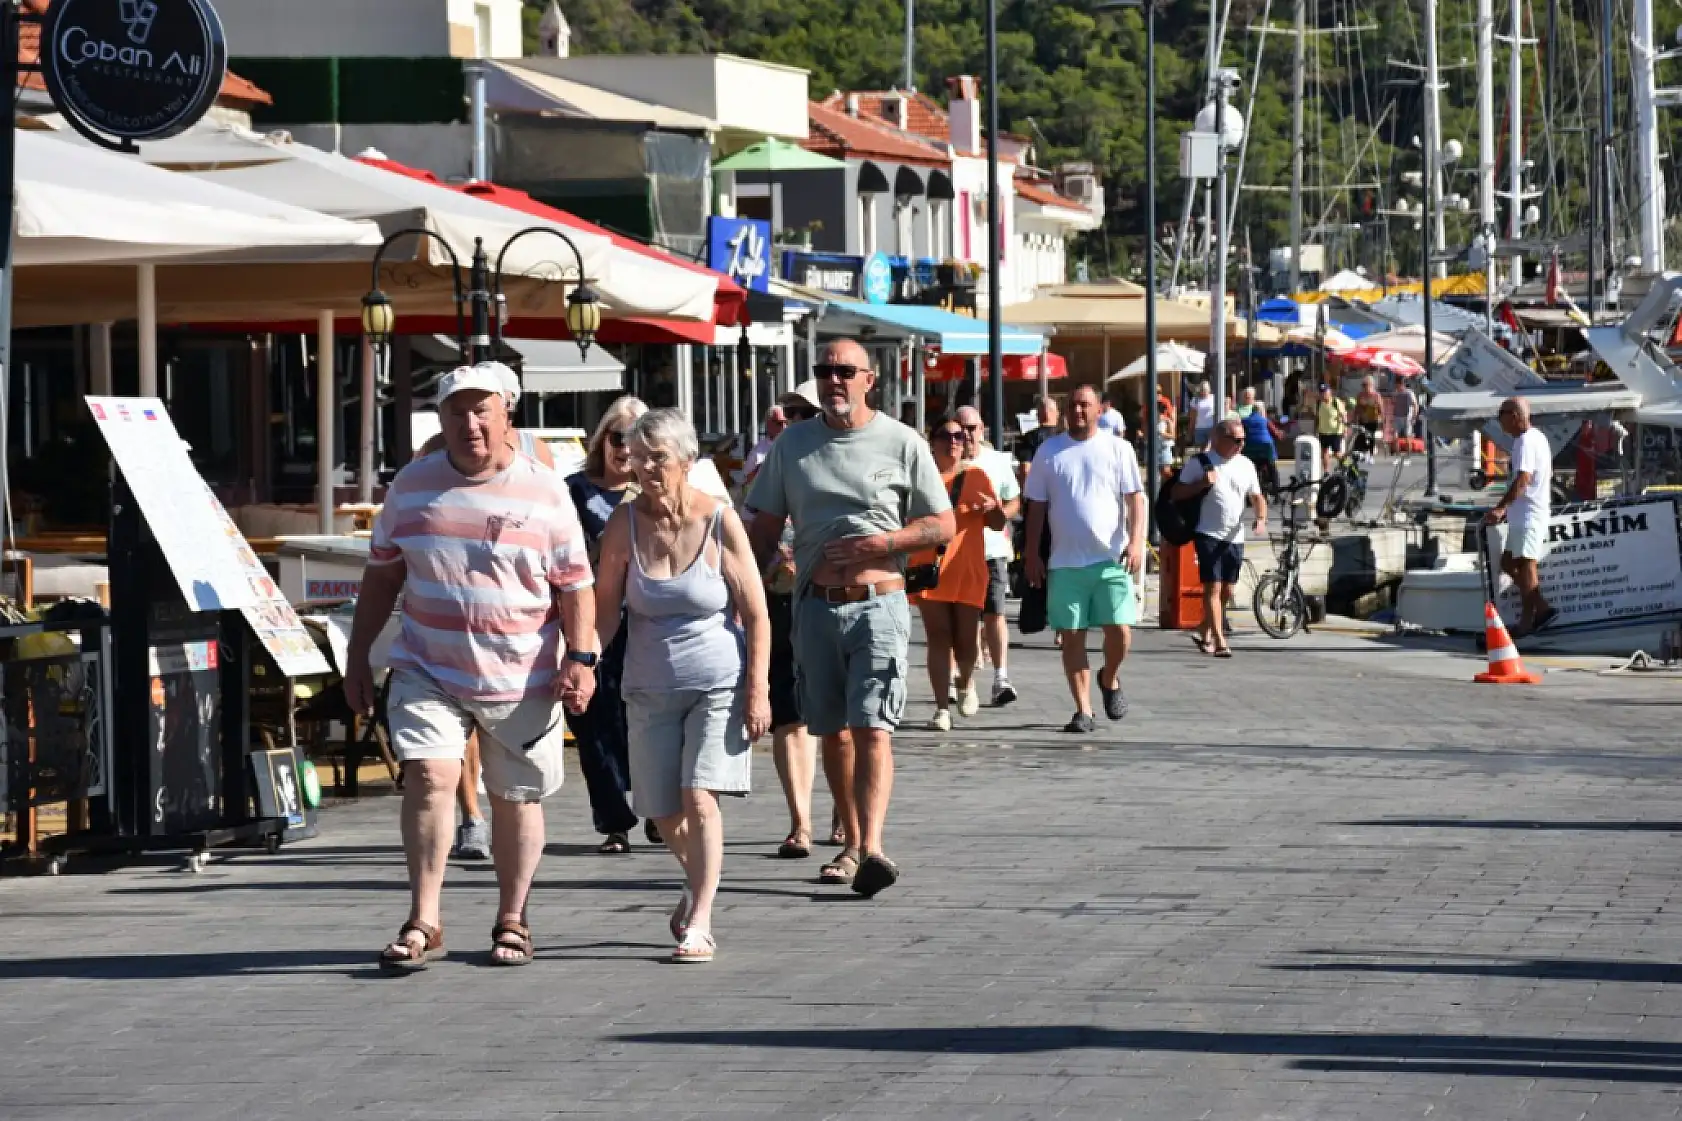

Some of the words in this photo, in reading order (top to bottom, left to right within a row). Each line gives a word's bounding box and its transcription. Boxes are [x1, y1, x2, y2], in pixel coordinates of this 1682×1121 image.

[160, 49, 202, 76] Ali
[1543, 511, 1649, 544] RİNİM
[1579, 543, 1587, 551] A
[1589, 539, 1616, 550] BOAT
